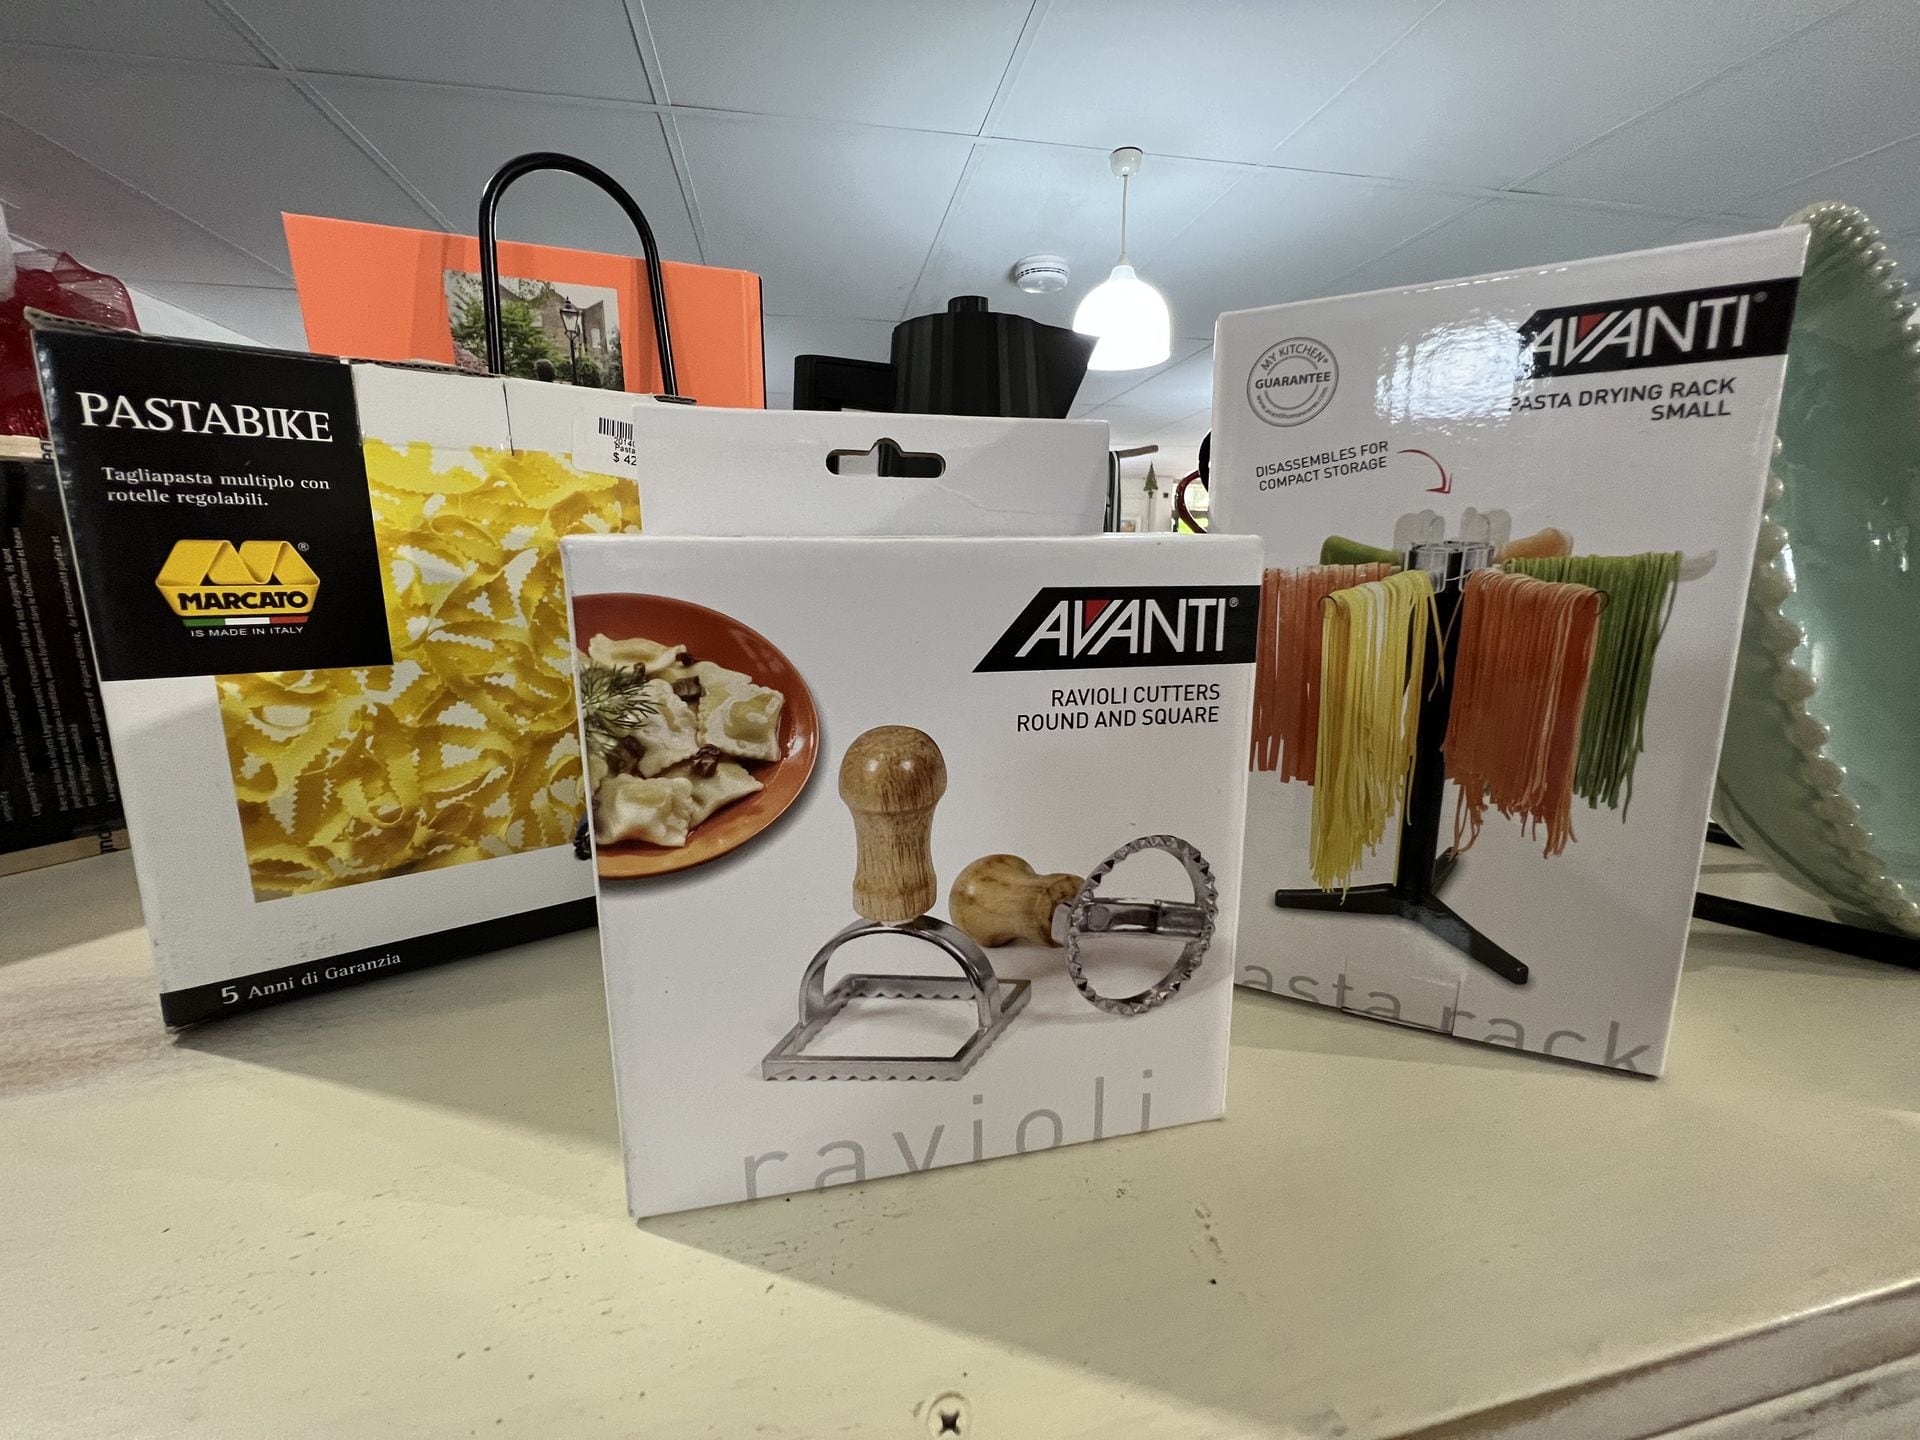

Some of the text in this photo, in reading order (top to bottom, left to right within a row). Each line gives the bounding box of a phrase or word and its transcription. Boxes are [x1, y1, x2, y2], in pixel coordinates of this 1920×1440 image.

[1533, 295, 1750, 367] AVANTI
[1261, 352, 1276, 371] MY
[1255, 371, 1331, 390] GUARANTEE
[1578, 385, 1663, 407] DRYING
[1670, 377, 1737, 399] RACK
[75, 391, 334, 443] PASTABIKE
[1651, 400, 1731, 421] SMALL
[1256, 440, 1389, 478] DISASSEMBLES FOR
[101, 466, 331, 490] Tagliapasta multiplo con
[1259, 456, 1388, 491] COMPACT STORAGE
[107, 488, 269, 507] rotelle regolabili.
[177, 590, 309, 611] MARCATO
[190, 630, 205, 638] IS
[208, 628, 248, 637] MADE
[269, 626, 304, 635] ITALY
[1014, 597, 1227, 660] AVANTI
[1052, 684, 1221, 707] RAVIOLI CUTTERS
[1017, 706, 1220, 732] ROUND AND SQUARE
[221, 954, 402, 1005] 5 Anni di Garanzia
[1243, 965, 1651, 1072] asta rack
[744, 1069, 1152, 1199] ravioli
